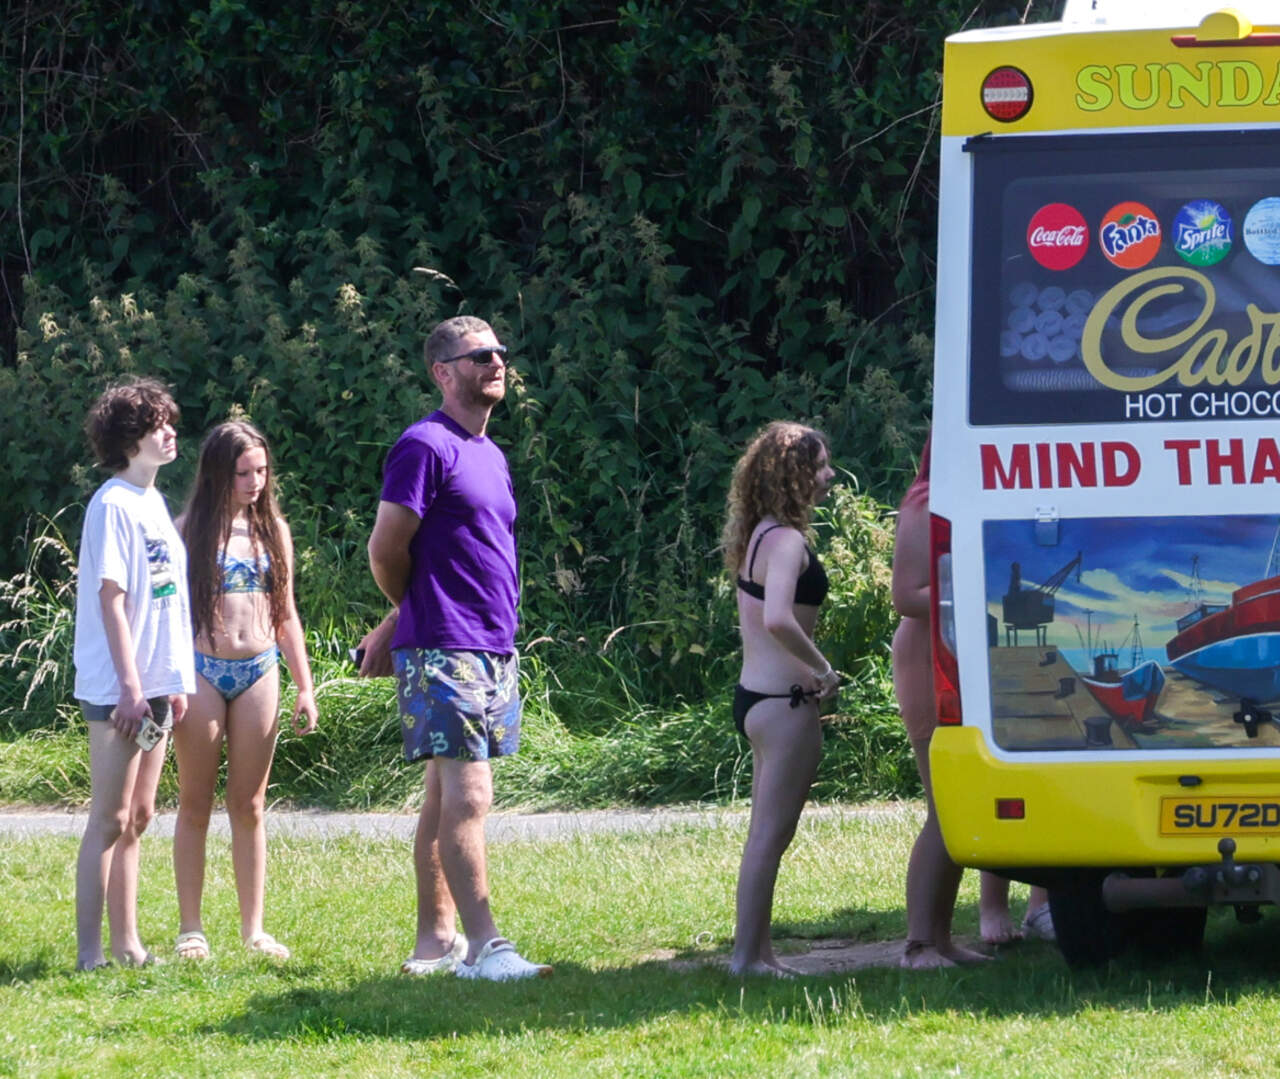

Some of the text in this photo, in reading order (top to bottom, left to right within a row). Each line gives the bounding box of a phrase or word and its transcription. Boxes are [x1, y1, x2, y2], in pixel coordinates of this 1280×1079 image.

[1101, 215, 1160, 257] Fanta
[1181, 223, 1225, 251] Sprite
[1125, 393, 1182, 418] HOT
[980, 441, 1141, 489] MIND
